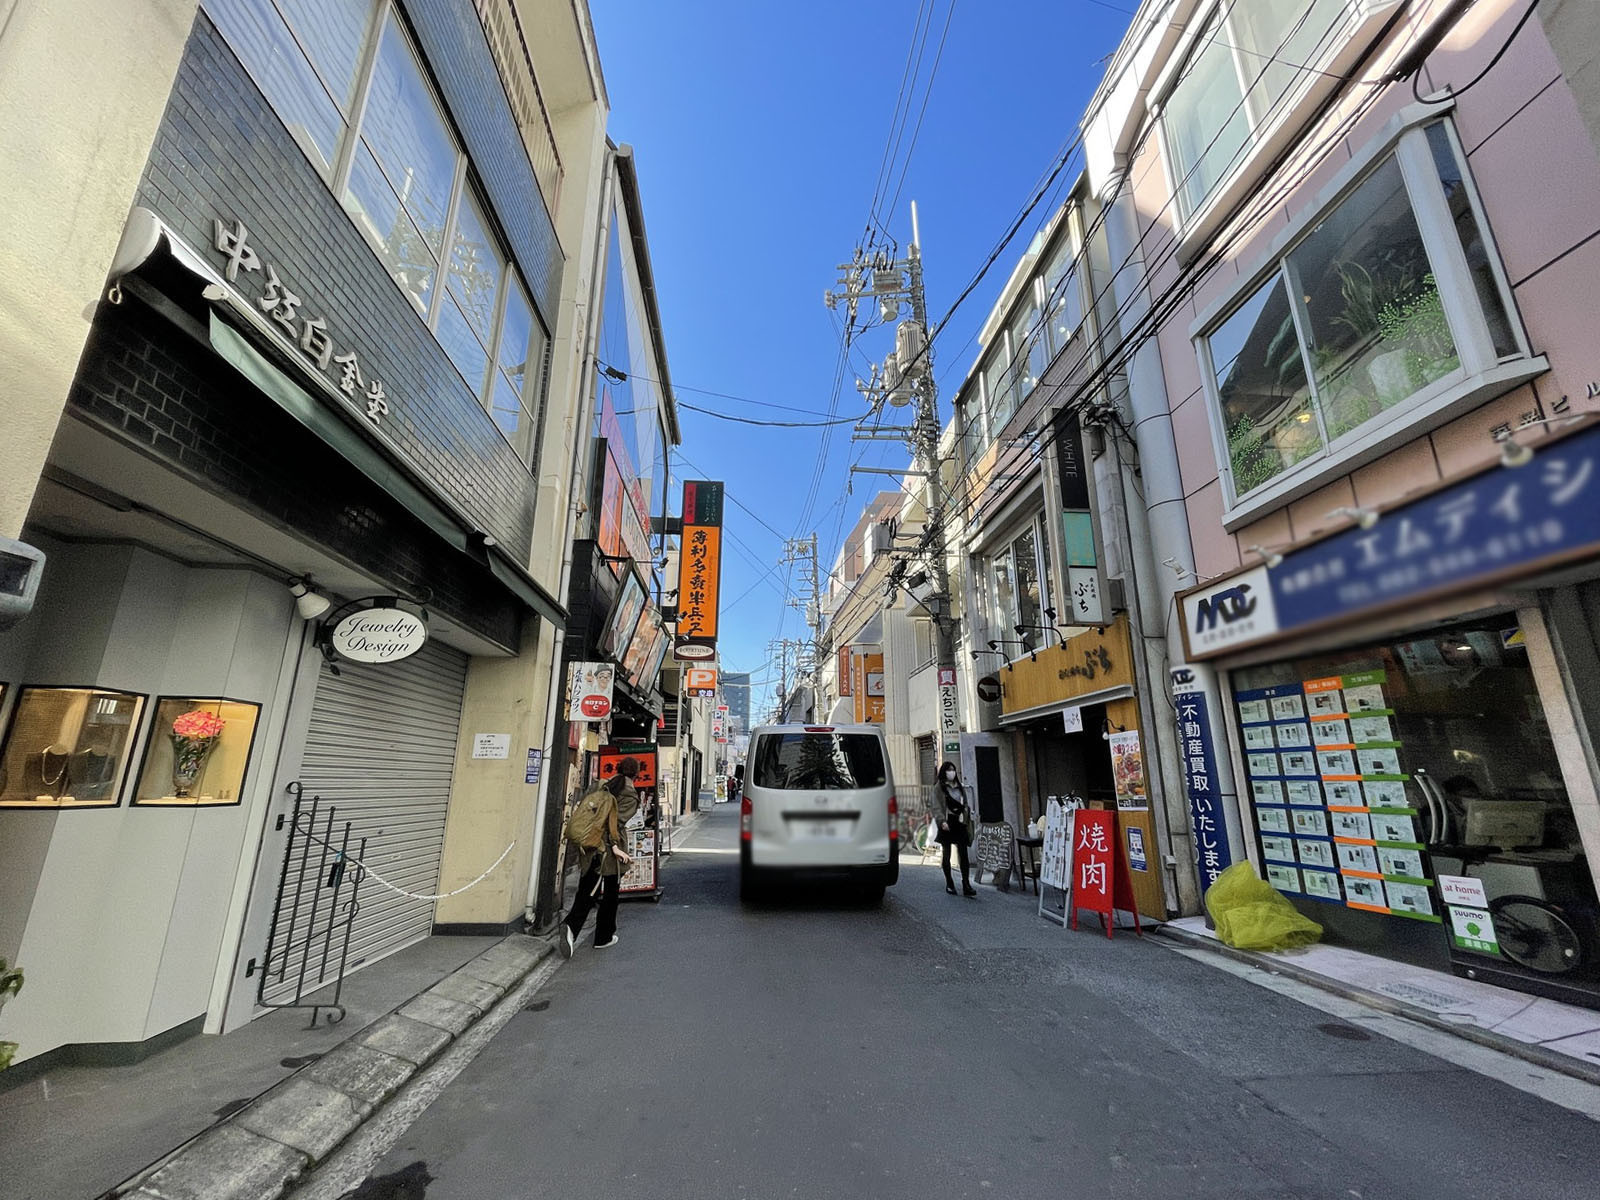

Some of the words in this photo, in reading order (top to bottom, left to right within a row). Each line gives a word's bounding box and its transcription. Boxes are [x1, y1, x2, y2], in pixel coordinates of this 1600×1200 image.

[1061, 438, 1078, 478] WHITE
[1074, 582, 1089, 613] ぶち
[1196, 583, 1257, 634] MDC
[339, 616, 419, 638] Jewelry
[345, 635, 411, 657] Design
[690, 671, 714, 686] P
[1182, 704, 1223, 886] 不動産買取いたします
[1076, 822, 1109, 896] 焼肉
[1455, 885, 1481, 896] home
